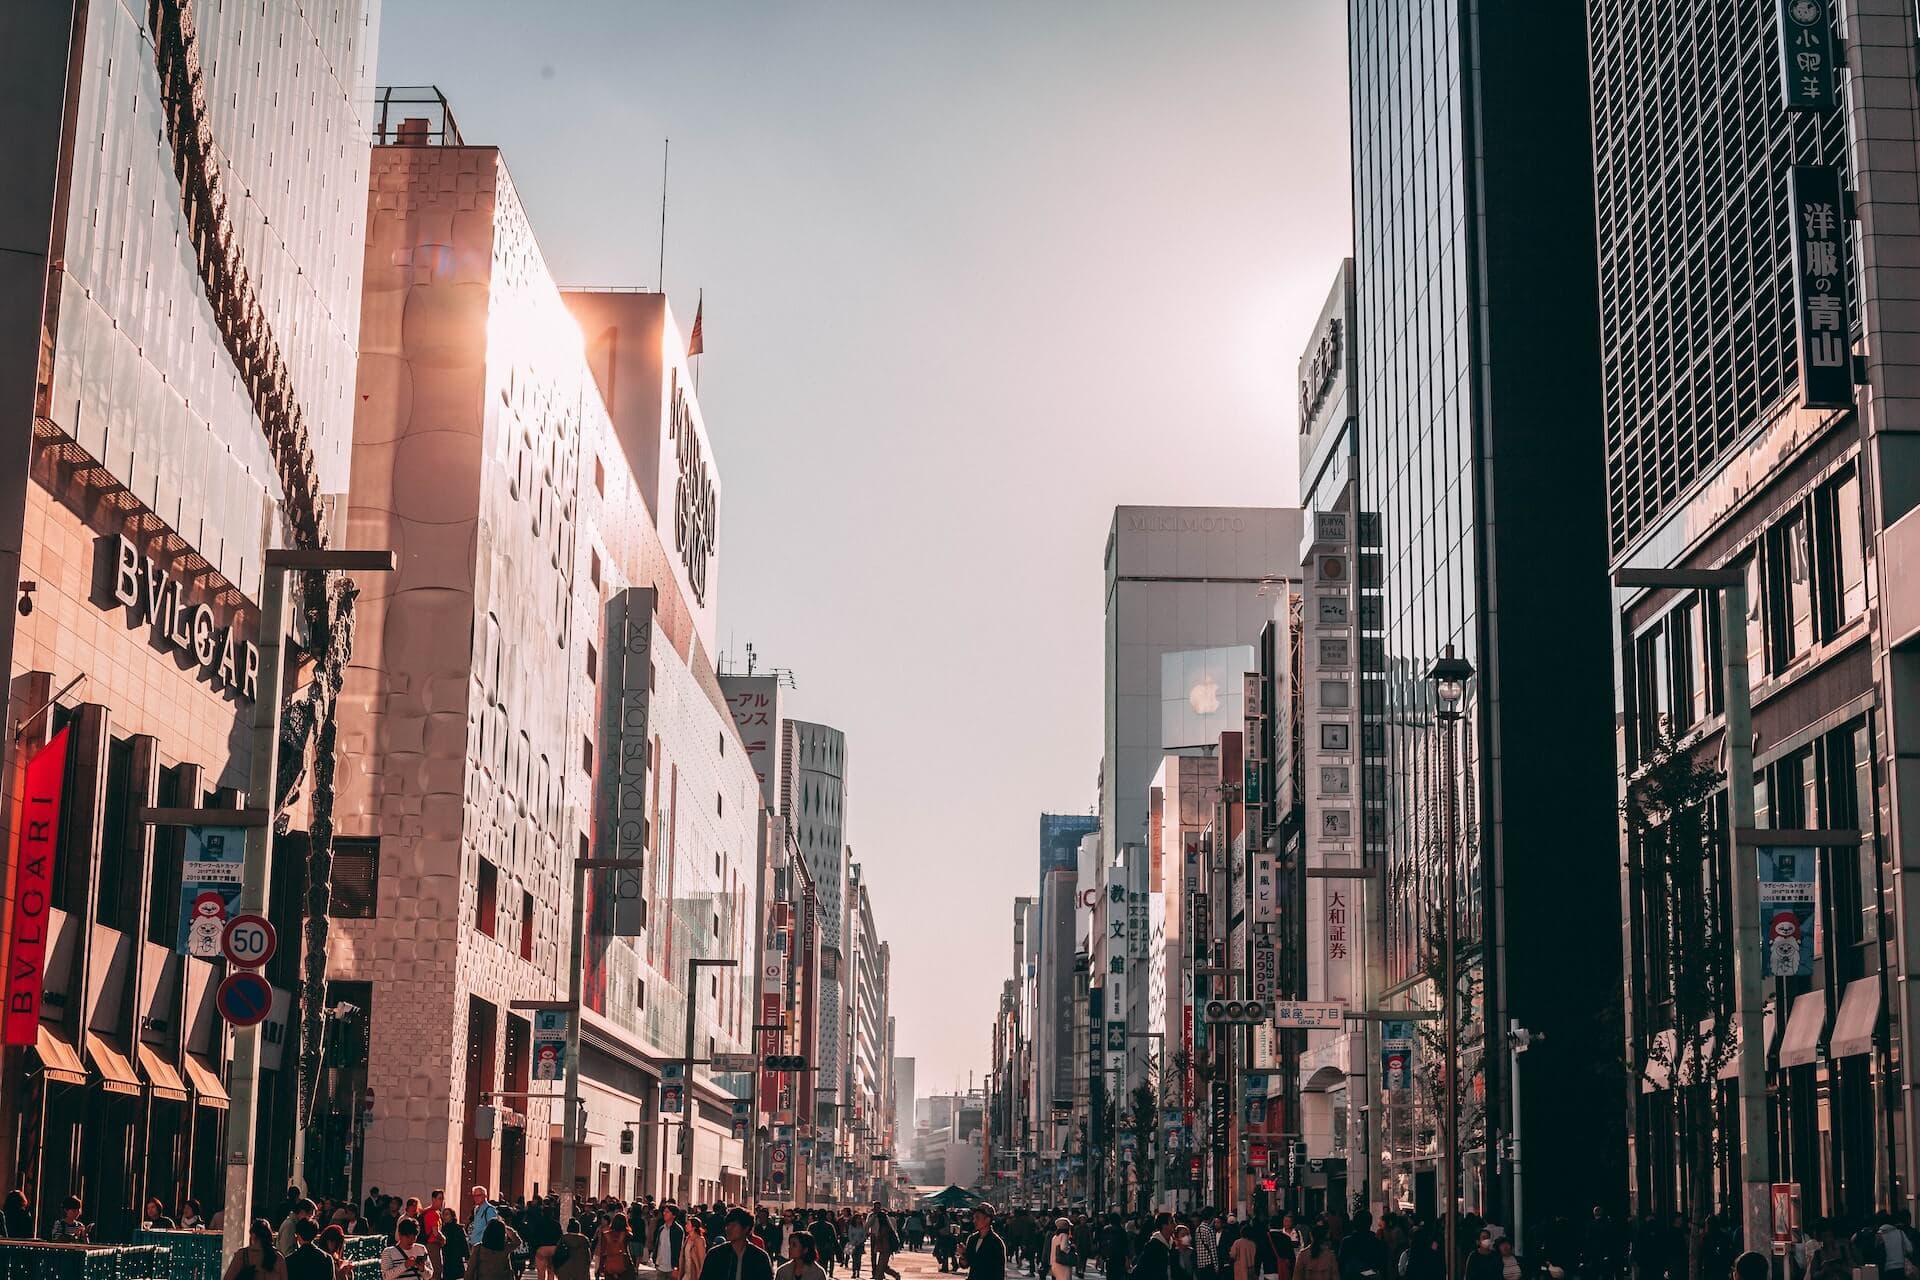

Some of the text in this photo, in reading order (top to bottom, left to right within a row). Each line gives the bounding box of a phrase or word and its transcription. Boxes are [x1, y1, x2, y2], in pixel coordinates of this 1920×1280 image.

[1796, 29, 1821, 99] 小肥羊
[1803, 203, 1843, 367] 洋服の青山
[1128, 516, 1247, 532] MIKIMOTO
[11, 798, 53, 1015] BVLGARI
[805, 886, 815, 951] MITSUKOSHI
[1110, 884, 1125, 975] 教文館
[1328, 891, 1347, 959] 大和証券
[234, 929, 264, 953] 50
[1280, 1007, 1339, 1019] 銀座二丁目
